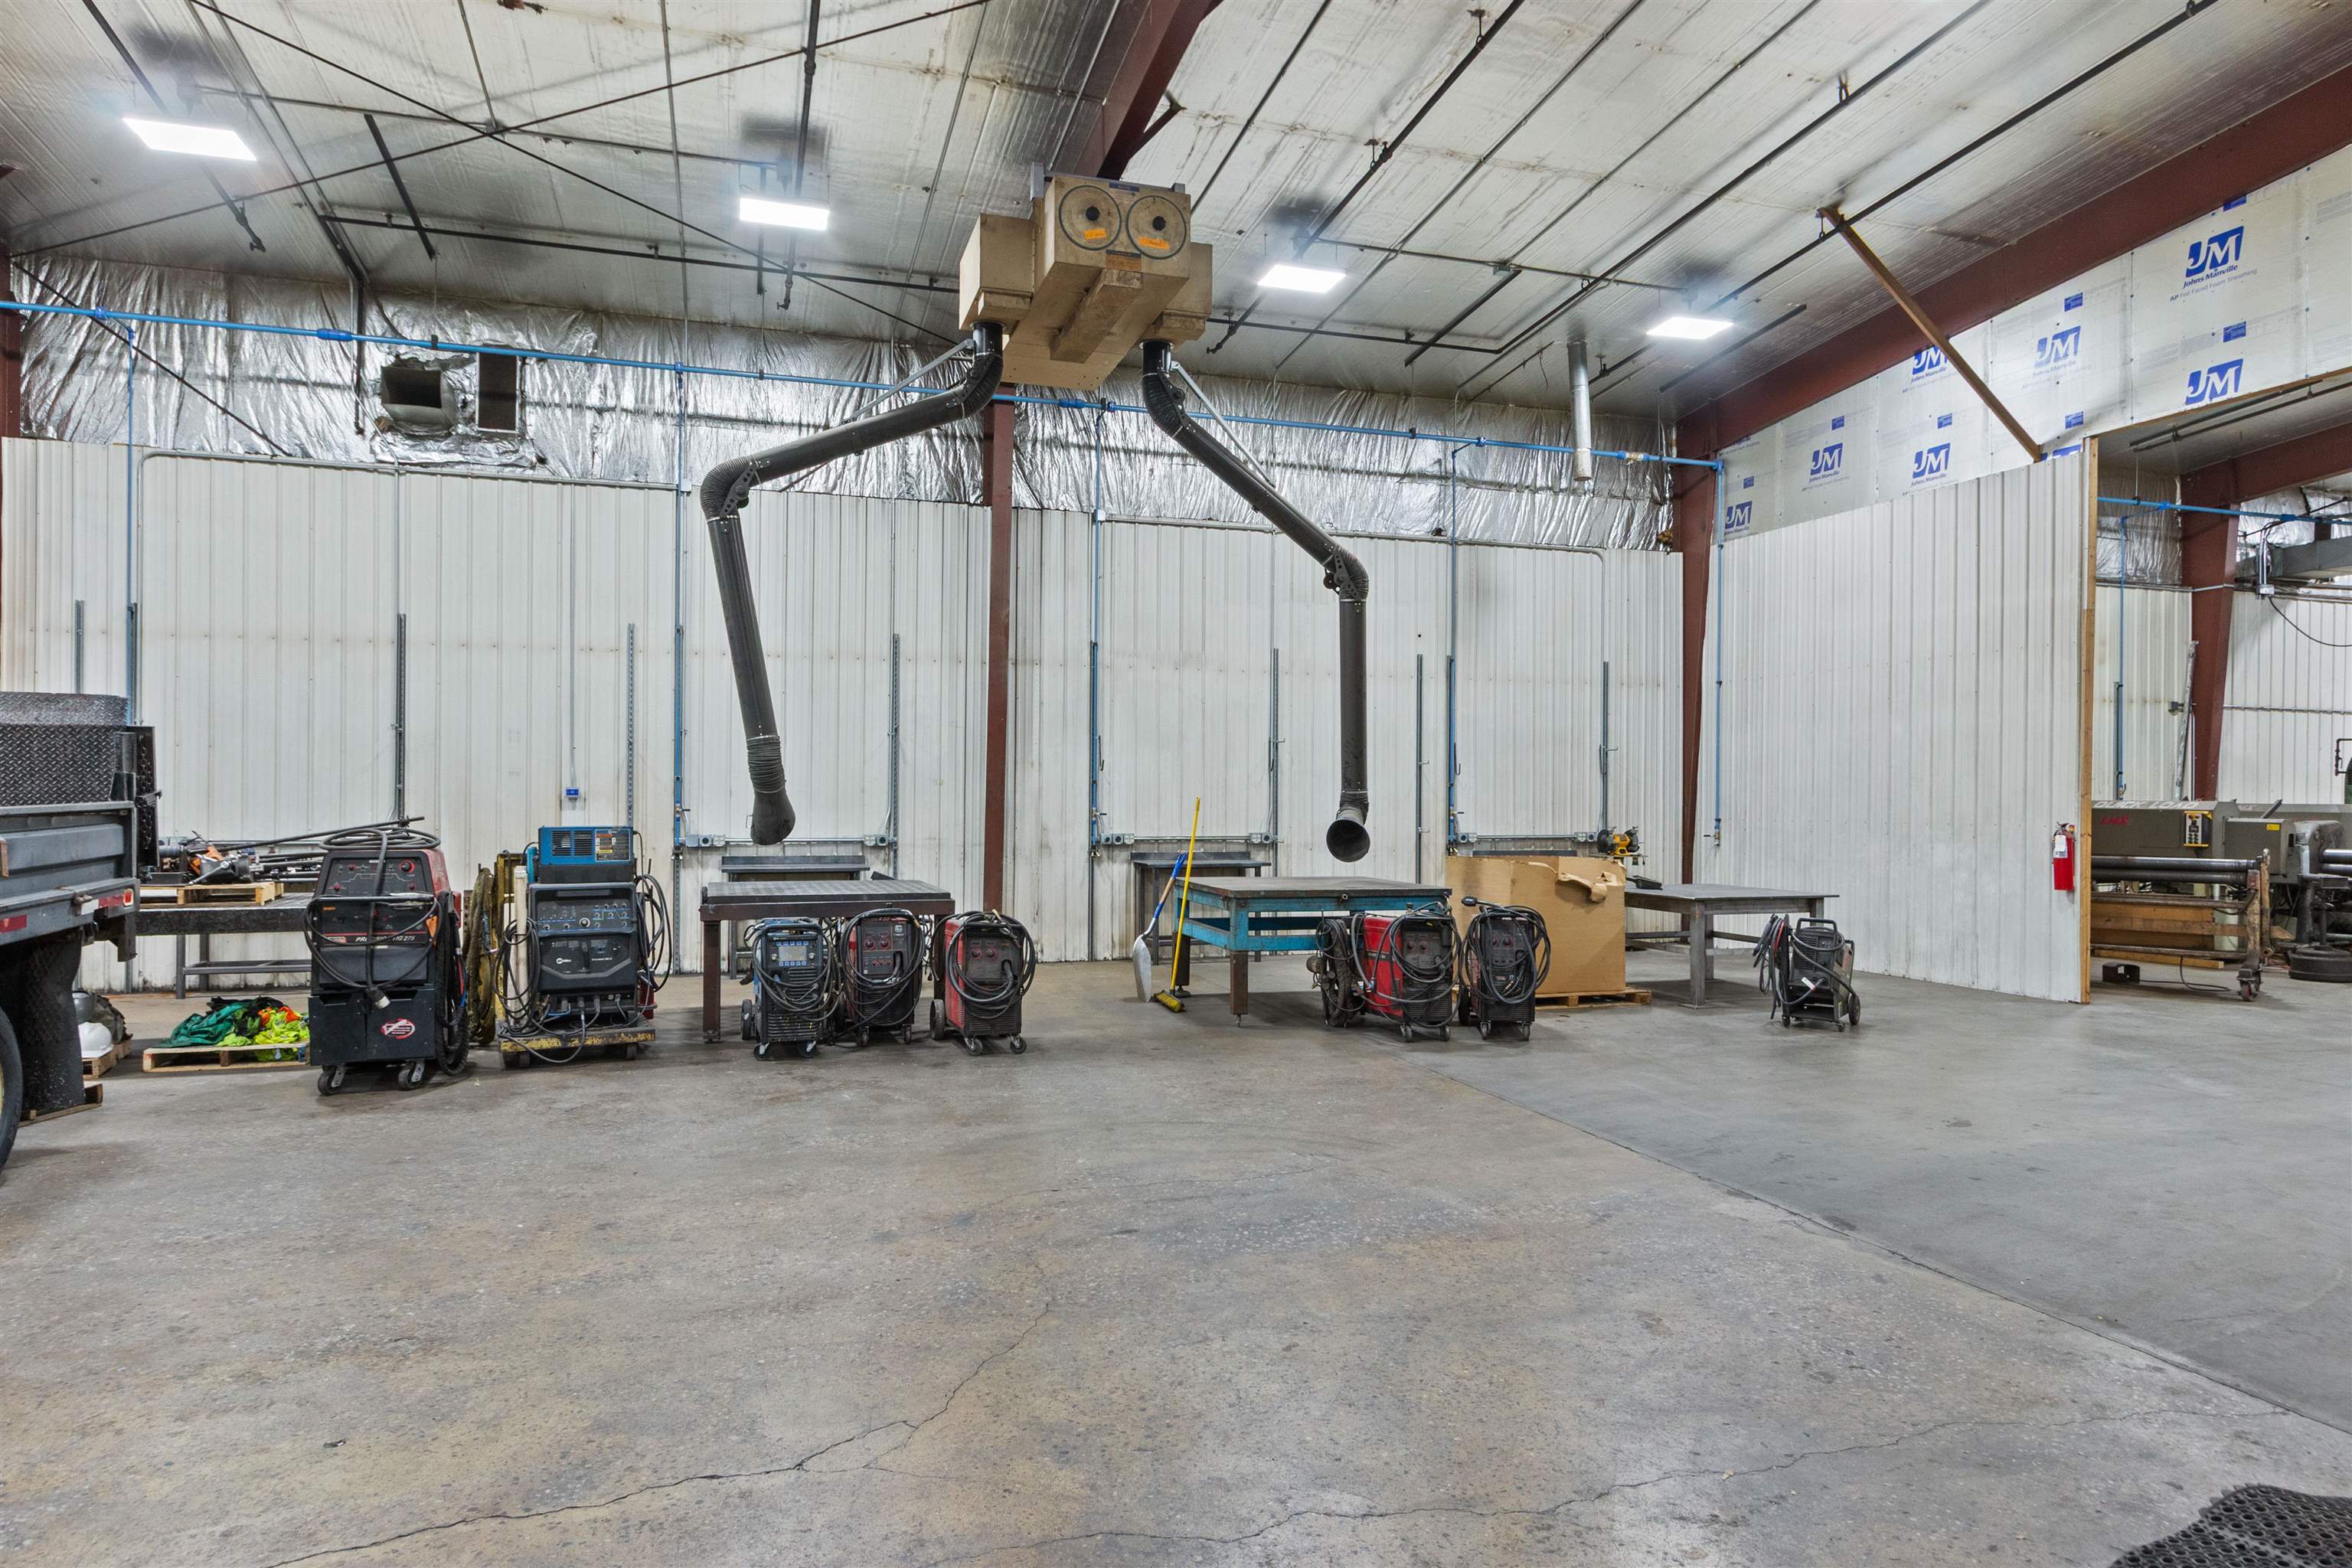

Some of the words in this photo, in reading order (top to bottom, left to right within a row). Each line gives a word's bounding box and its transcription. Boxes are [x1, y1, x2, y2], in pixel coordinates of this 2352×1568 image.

[2186, 225, 2244, 278] JM
[2182, 276, 2205, 289] Johns
[2205, 264, 2238, 280] Manville
[2034, 325, 2081, 368] JM
[2185, 358, 2243, 405] JM
[1810, 443, 1843, 475] JM
[1913, 443, 1951, 479] JM
[1725, 501, 1753, 529] JM
[2148, 801, 2200, 809] LOAD
